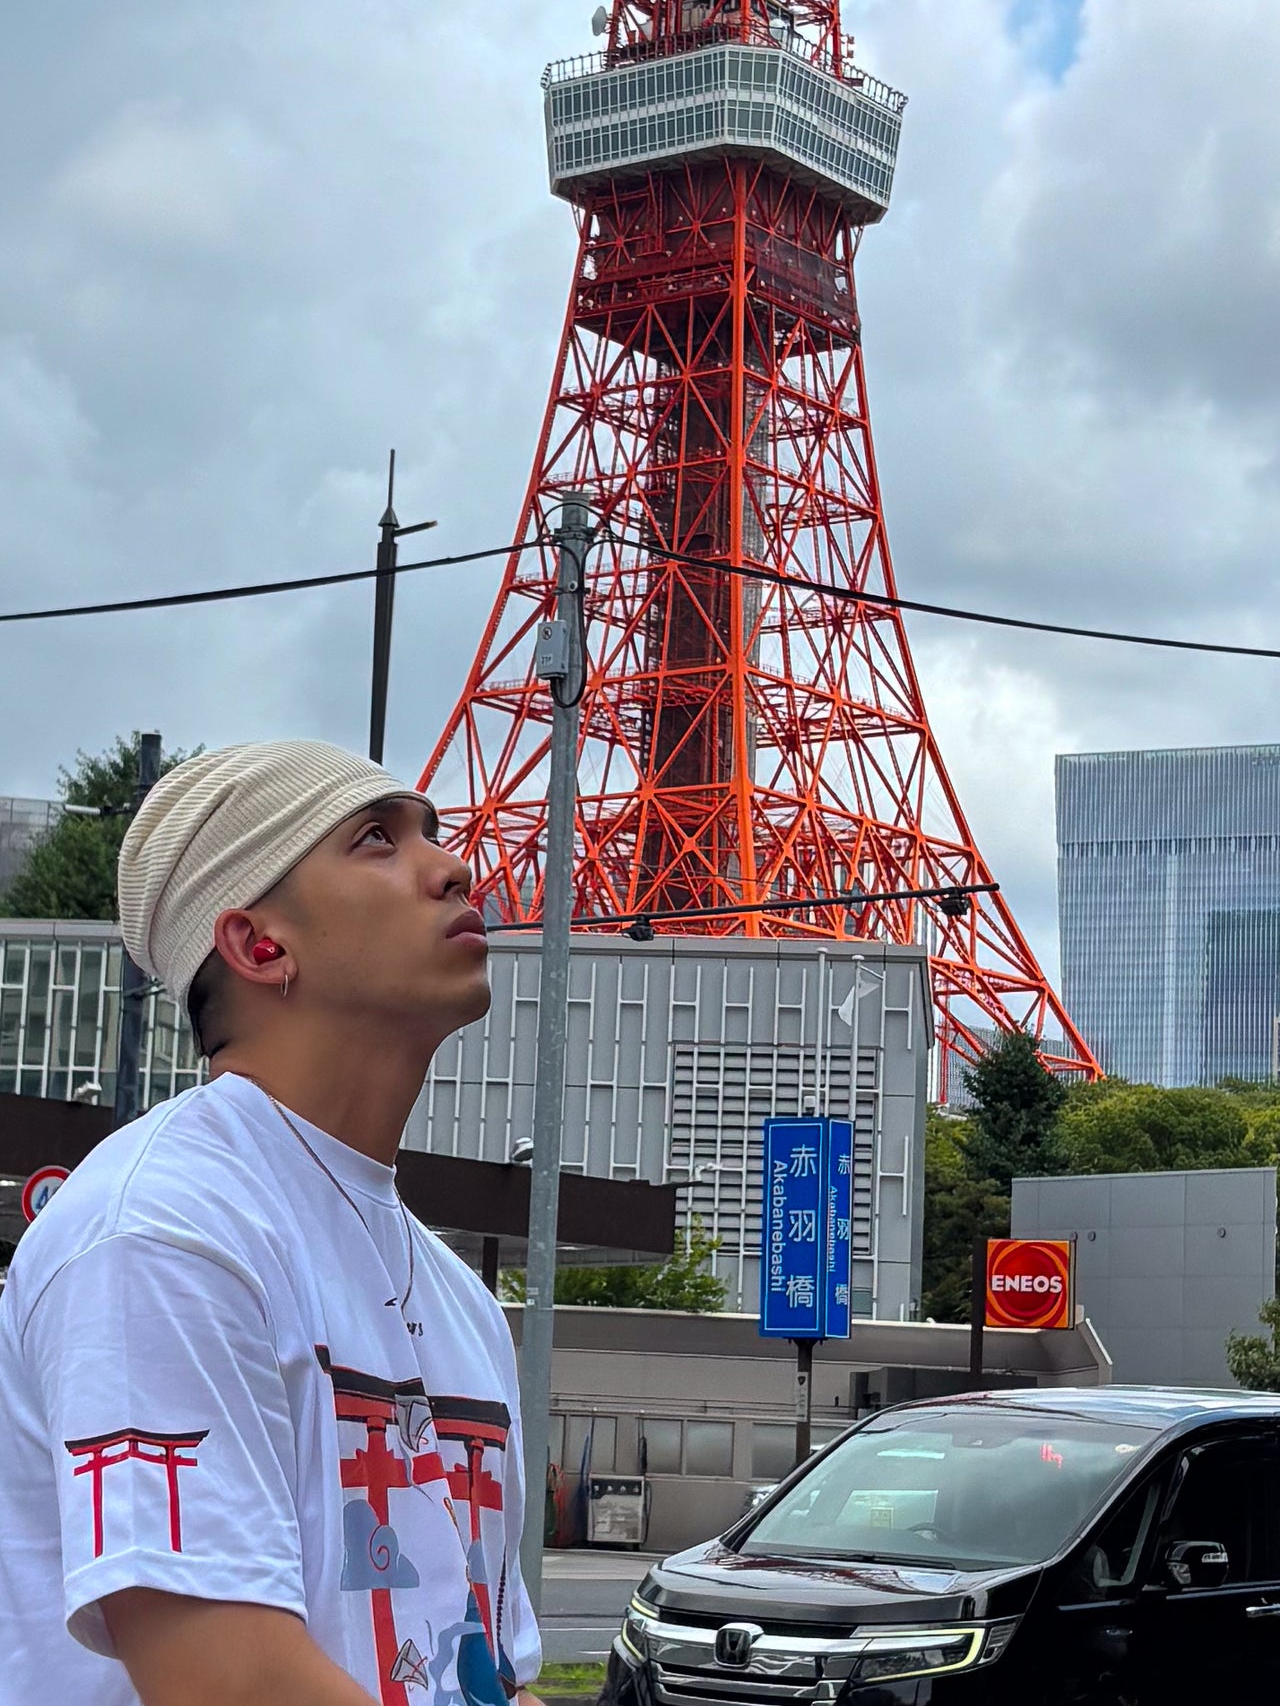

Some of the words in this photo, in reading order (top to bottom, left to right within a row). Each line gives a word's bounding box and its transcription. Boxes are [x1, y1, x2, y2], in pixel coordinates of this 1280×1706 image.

[770, 1159, 788, 1292] Akabanebashi
[785, 1143, 818, 1309] 赤羽橋
[991, 1274, 1063, 1294] ENEOS
